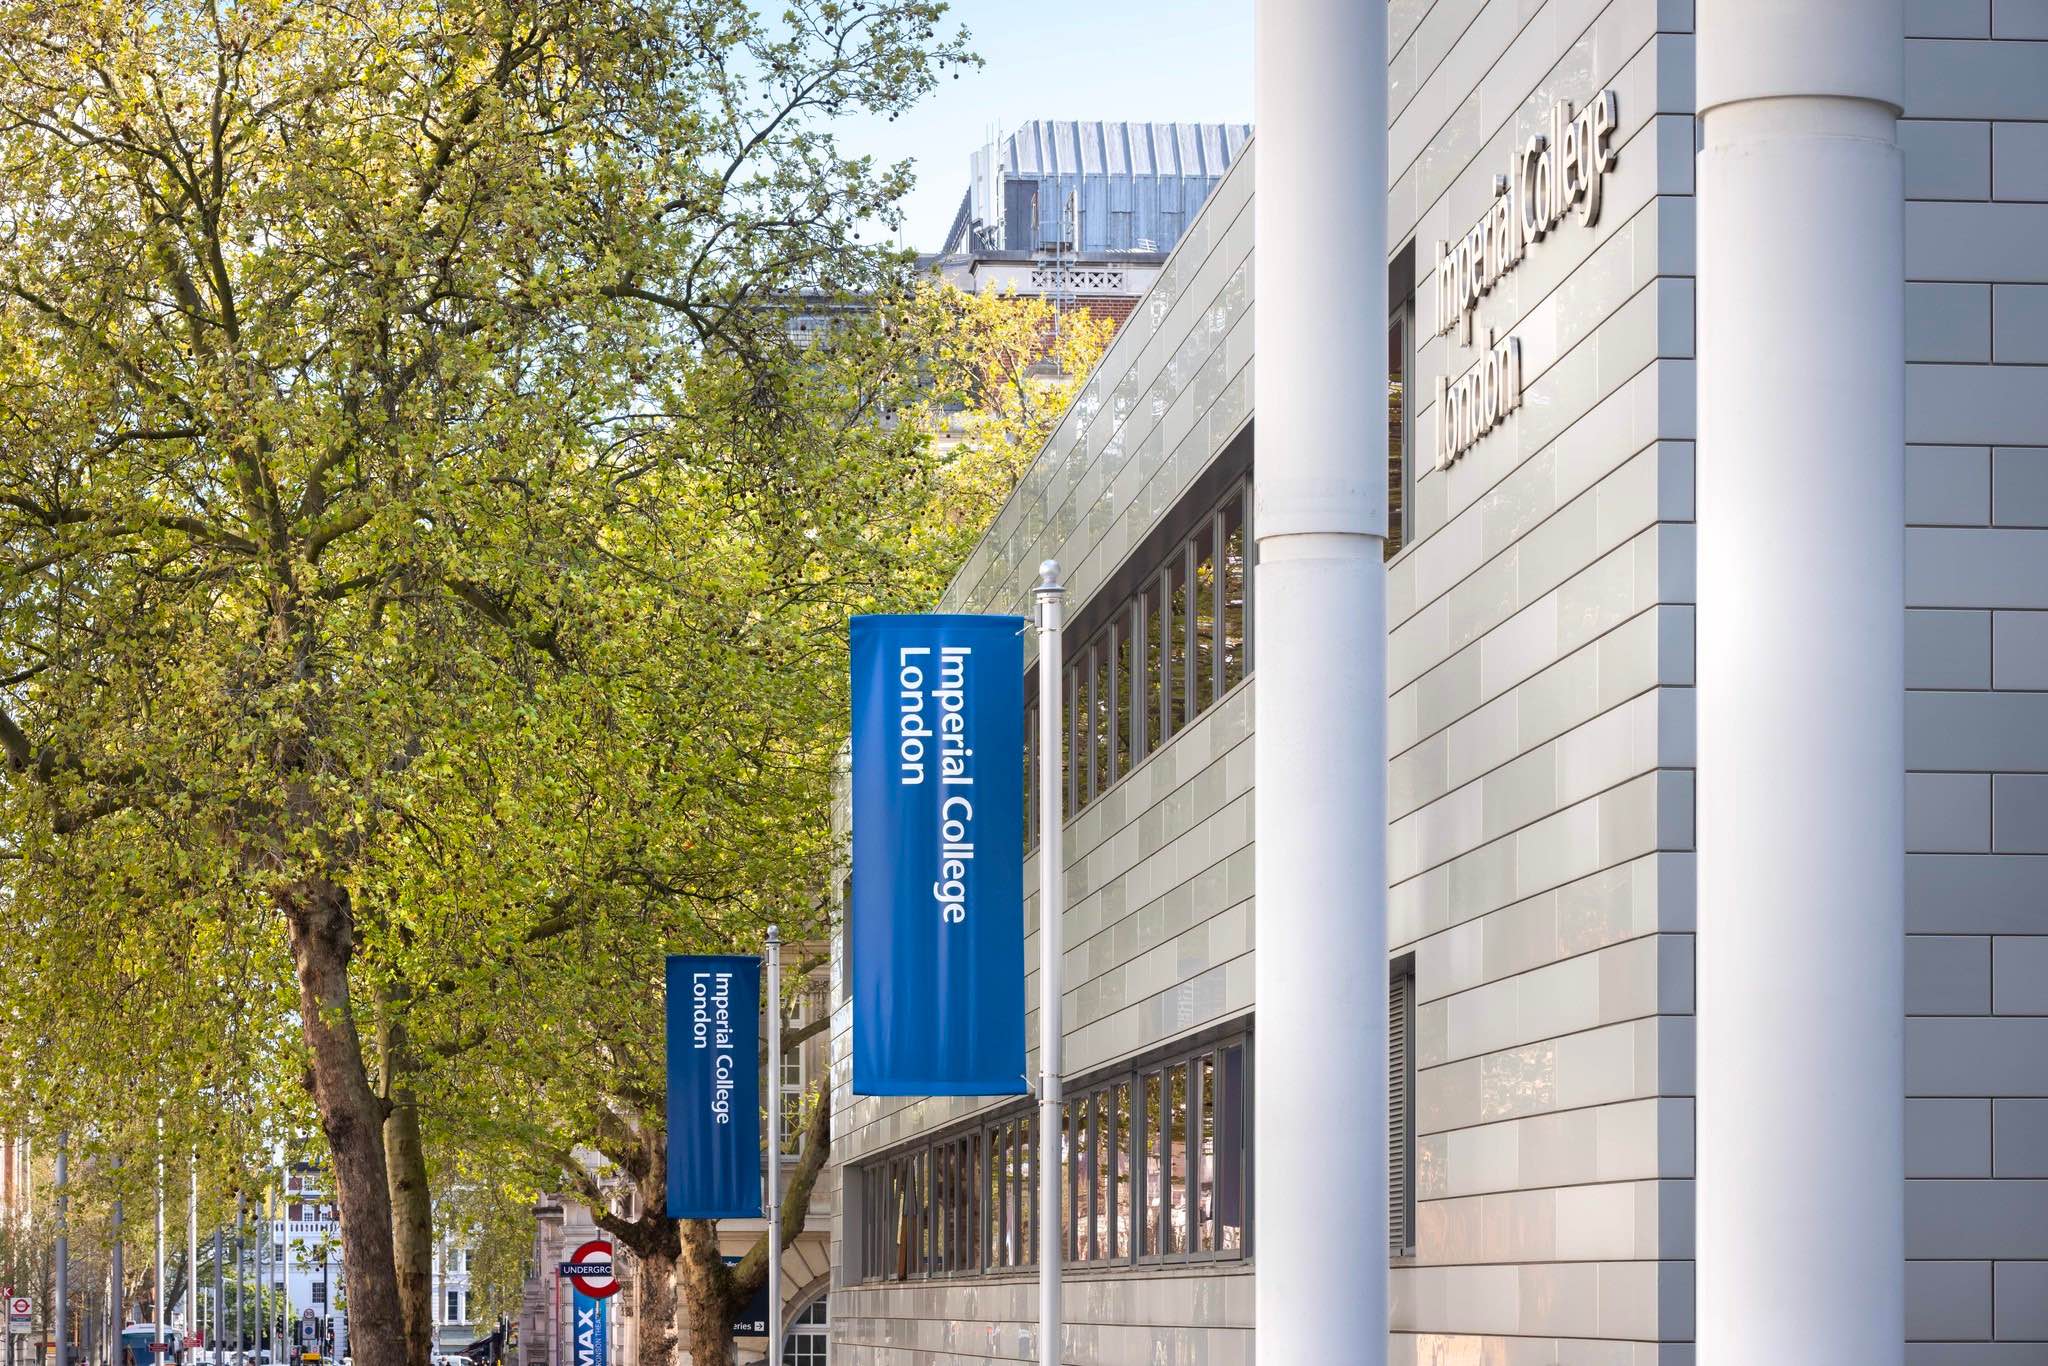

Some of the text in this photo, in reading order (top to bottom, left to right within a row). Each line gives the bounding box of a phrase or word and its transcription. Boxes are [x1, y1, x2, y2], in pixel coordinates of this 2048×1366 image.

[1435, 90, 1618, 347] Imperial College
[1435, 328, 1523, 472] London
[900, 647, 934, 785] London
[932, 647, 974, 924] Imperial College
[693, 973, 711, 1049] London
[711, 973, 734, 1124] Imperial College
[3, 1287, 11, 1296] K
